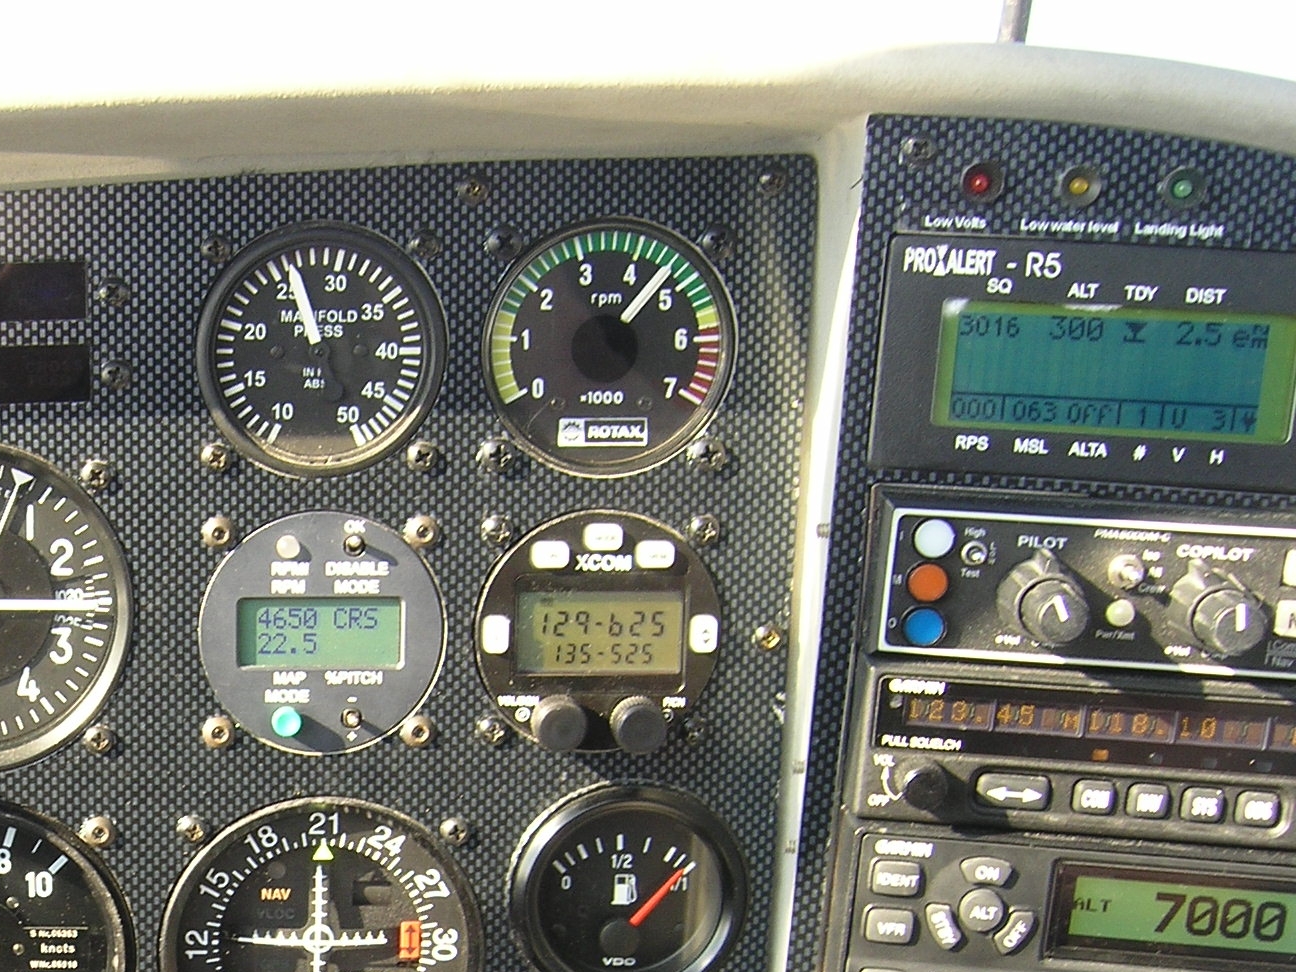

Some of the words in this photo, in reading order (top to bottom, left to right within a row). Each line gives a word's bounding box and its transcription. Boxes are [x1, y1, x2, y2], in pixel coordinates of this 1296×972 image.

[925, 216, 953, 229] Low
[954, 217, 986, 230] Volts
[1135, 223, 1185, 239] Landing
[1189, 223, 1225, 239] Light
[579, 265, 592, 285] 3
[623, 264, 636, 285] 4
[324, 276, 346, 292] 30
[986, 278, 1012, 294] SQ
[1067, 283, 1099, 299] ALT
[1124, 285, 1159, 302] TDY
[1185, 288, 1227, 304] DIST
[540, 289, 553, 310] 2
[591, 292, 622, 308] rpm
[659, 290, 671, 310] 5
[361, 304, 384, 321] 35
[244, 324, 266, 340] 20
[376, 343, 398, 359] 40
[244, 371, 265, 387] 15
[532, 378, 544, 398] 0
[361, 382, 384, 398] 45
[588, 426, 646, 439] ROTAX
[955, 435, 989, 451] RPS
[1014, 439, 1049, 455] MSL
[1069, 441, 1107, 458] ALTA
[344, 520, 366, 533] OK
[1017, 535, 1067, 550] PILOT
[50, 538, 74, 576] 2
[1176, 544, 1255, 562] COPILOT
[575, 554, 633, 571] XCOM
[960, 568, 980, 579] Test
[271, 580, 306, 594] RPM
[334, 580, 379, 594] MODE
[258, 608, 317, 629] 4650
[334, 608, 378, 629] CRS
[49, 627, 73, 665] 3
[258, 633, 317, 654] 22.5
[17, 666, 40, 702] 4
[265, 689, 310, 703] MODE
[873, 753, 895, 767] VOL
[308, 812, 339, 836] 21
[244, 825, 280, 854] 18
[366, 825, 406, 857] 24
[611, 854, 633, 869] 1/2
[876, 871, 919, 889] IDENT
[974, 864, 1001, 882] ON
[24, 871, 53, 897] 10
[199, 867, 229, 899] 15
[413, 868, 450, 901] 27
[561, 876, 571, 889] 0
[260, 888, 291, 901] NAV
[969, 905, 998, 921] ALT
[1073, 897, 1112, 914] ALT
[1153, 891, 1287, 943] 7000
[876, 921, 907, 937] VFR
[1002, 918, 1027, 948] OFF
[40, 943, 76, 955] knots
[184, 929, 209, 959] 12
[431, 927, 457, 961] 30
[603, 957, 635, 967] VDO
